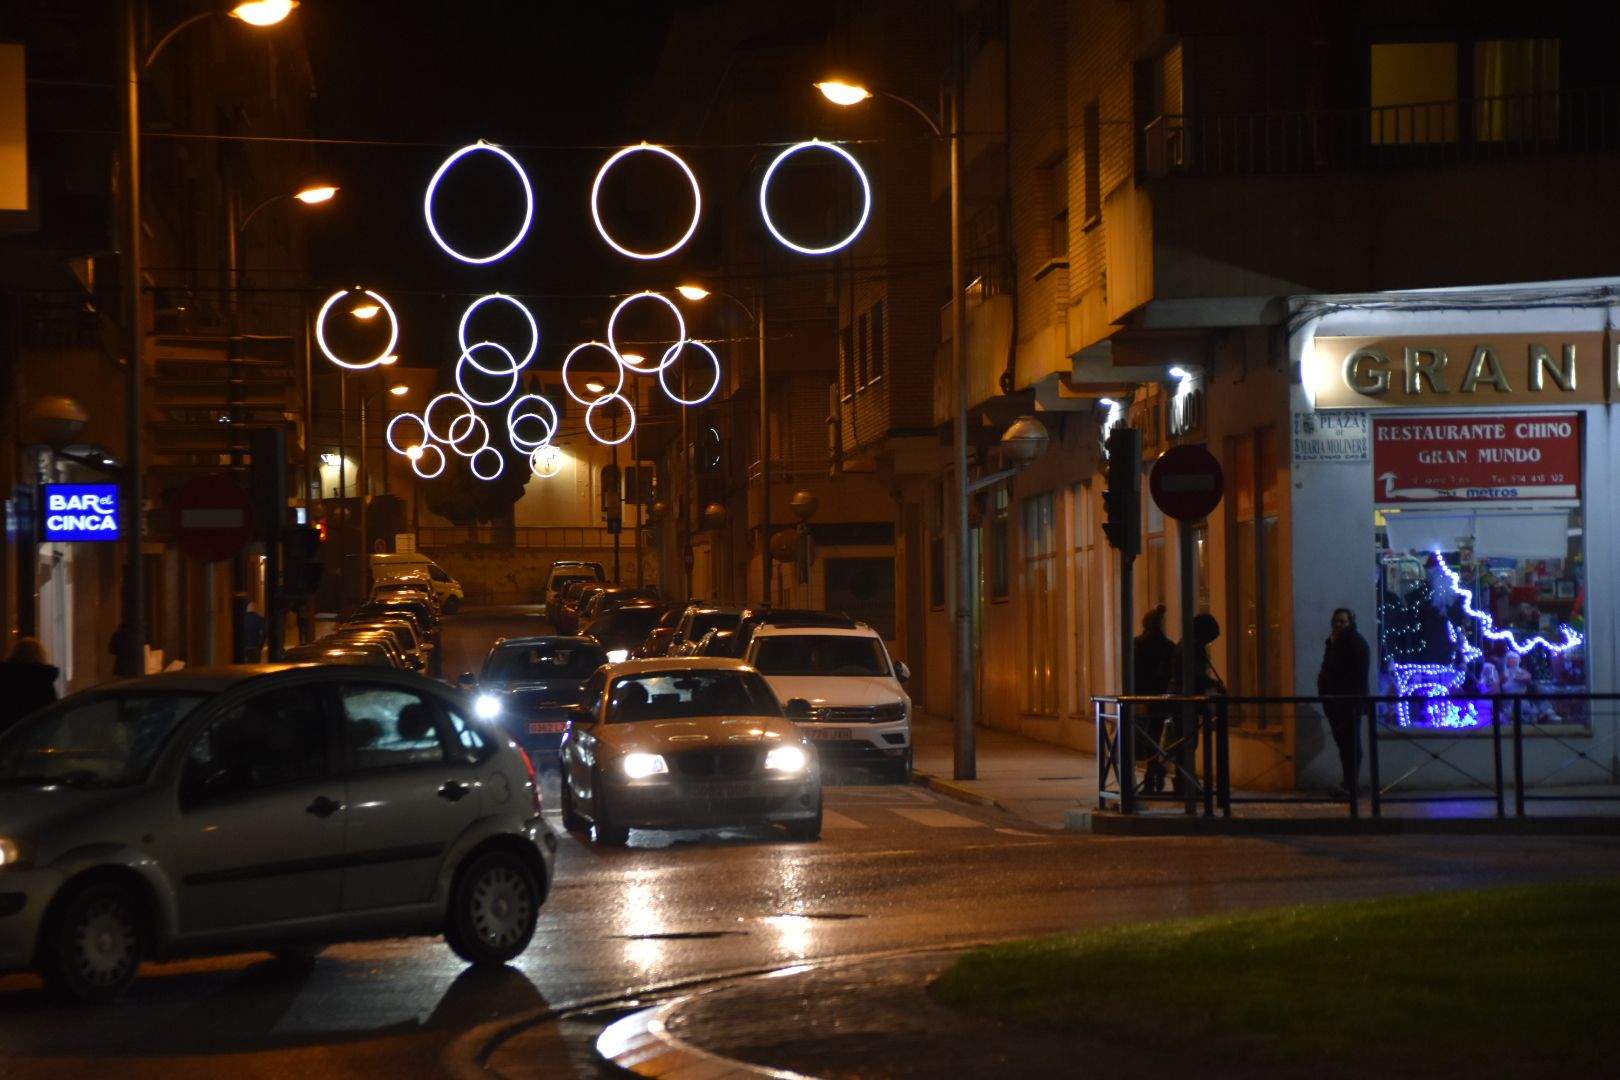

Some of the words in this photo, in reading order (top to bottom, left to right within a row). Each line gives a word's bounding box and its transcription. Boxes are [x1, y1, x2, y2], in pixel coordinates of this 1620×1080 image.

[1343, 342, 1577, 395] GRAN
[1320, 415, 1360, 429] PLAZA
[1377, 425, 1506, 441] RESTAURANTE
[1515, 422, 1572, 438] CHINO
[1327, 438, 1363, 454] MOLINER
[1418, 449, 1468, 464] GRAN
[1478, 447, 1542, 463] MUNDO
[1465, 487, 1519, 498] metros
[49, 494, 115, 514] BAR
[46, 514, 118, 531] CINCA
